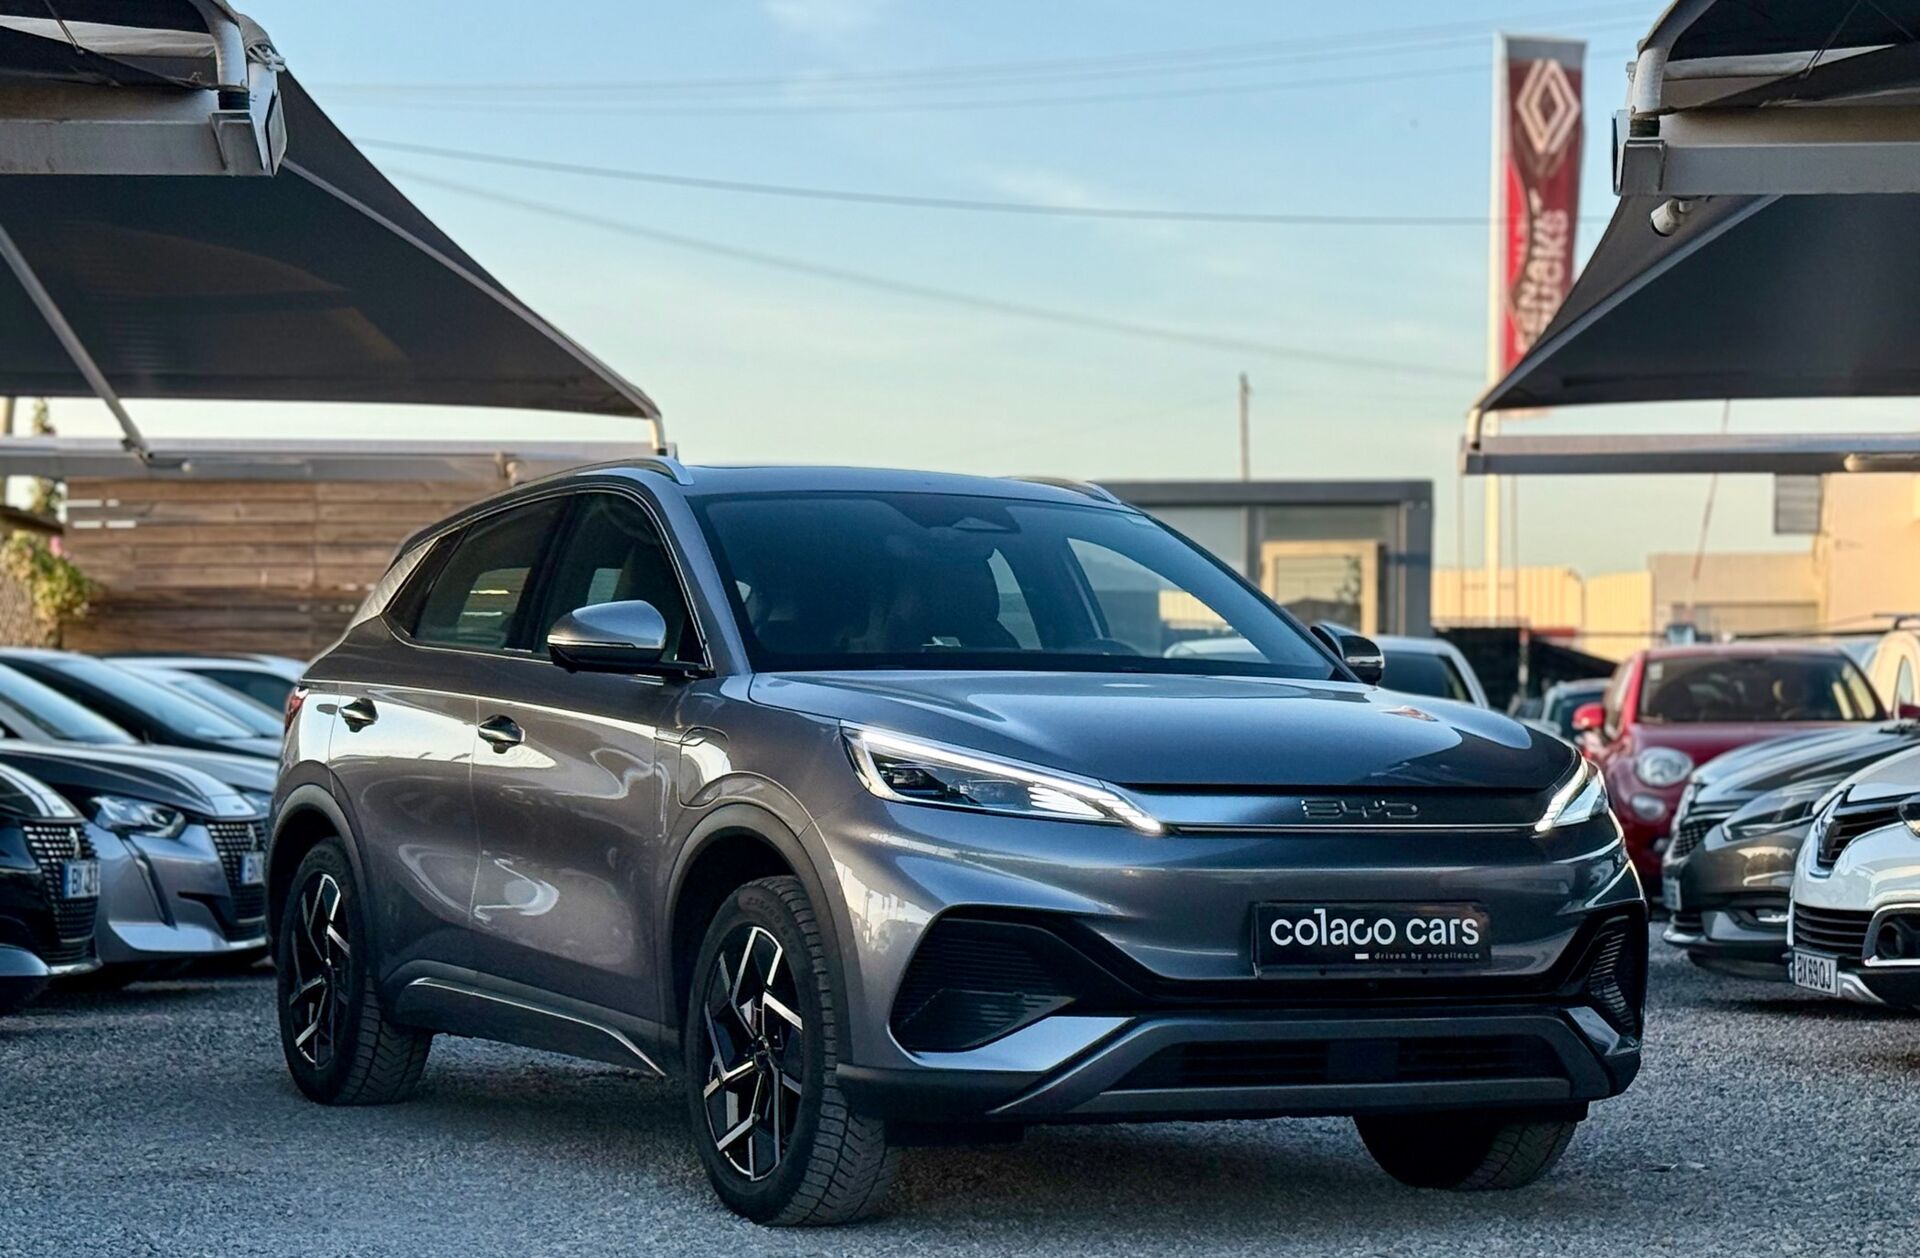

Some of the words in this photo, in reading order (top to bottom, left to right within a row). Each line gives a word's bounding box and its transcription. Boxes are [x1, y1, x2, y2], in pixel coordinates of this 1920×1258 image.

[1301, 800, 1420, 819] BYD
[1406, 918, 1480, 945] cars
[1374, 952, 1407, 960] driven
[1411, 952, 1423, 961] by
[1427, 952, 1480, 960] excellence
